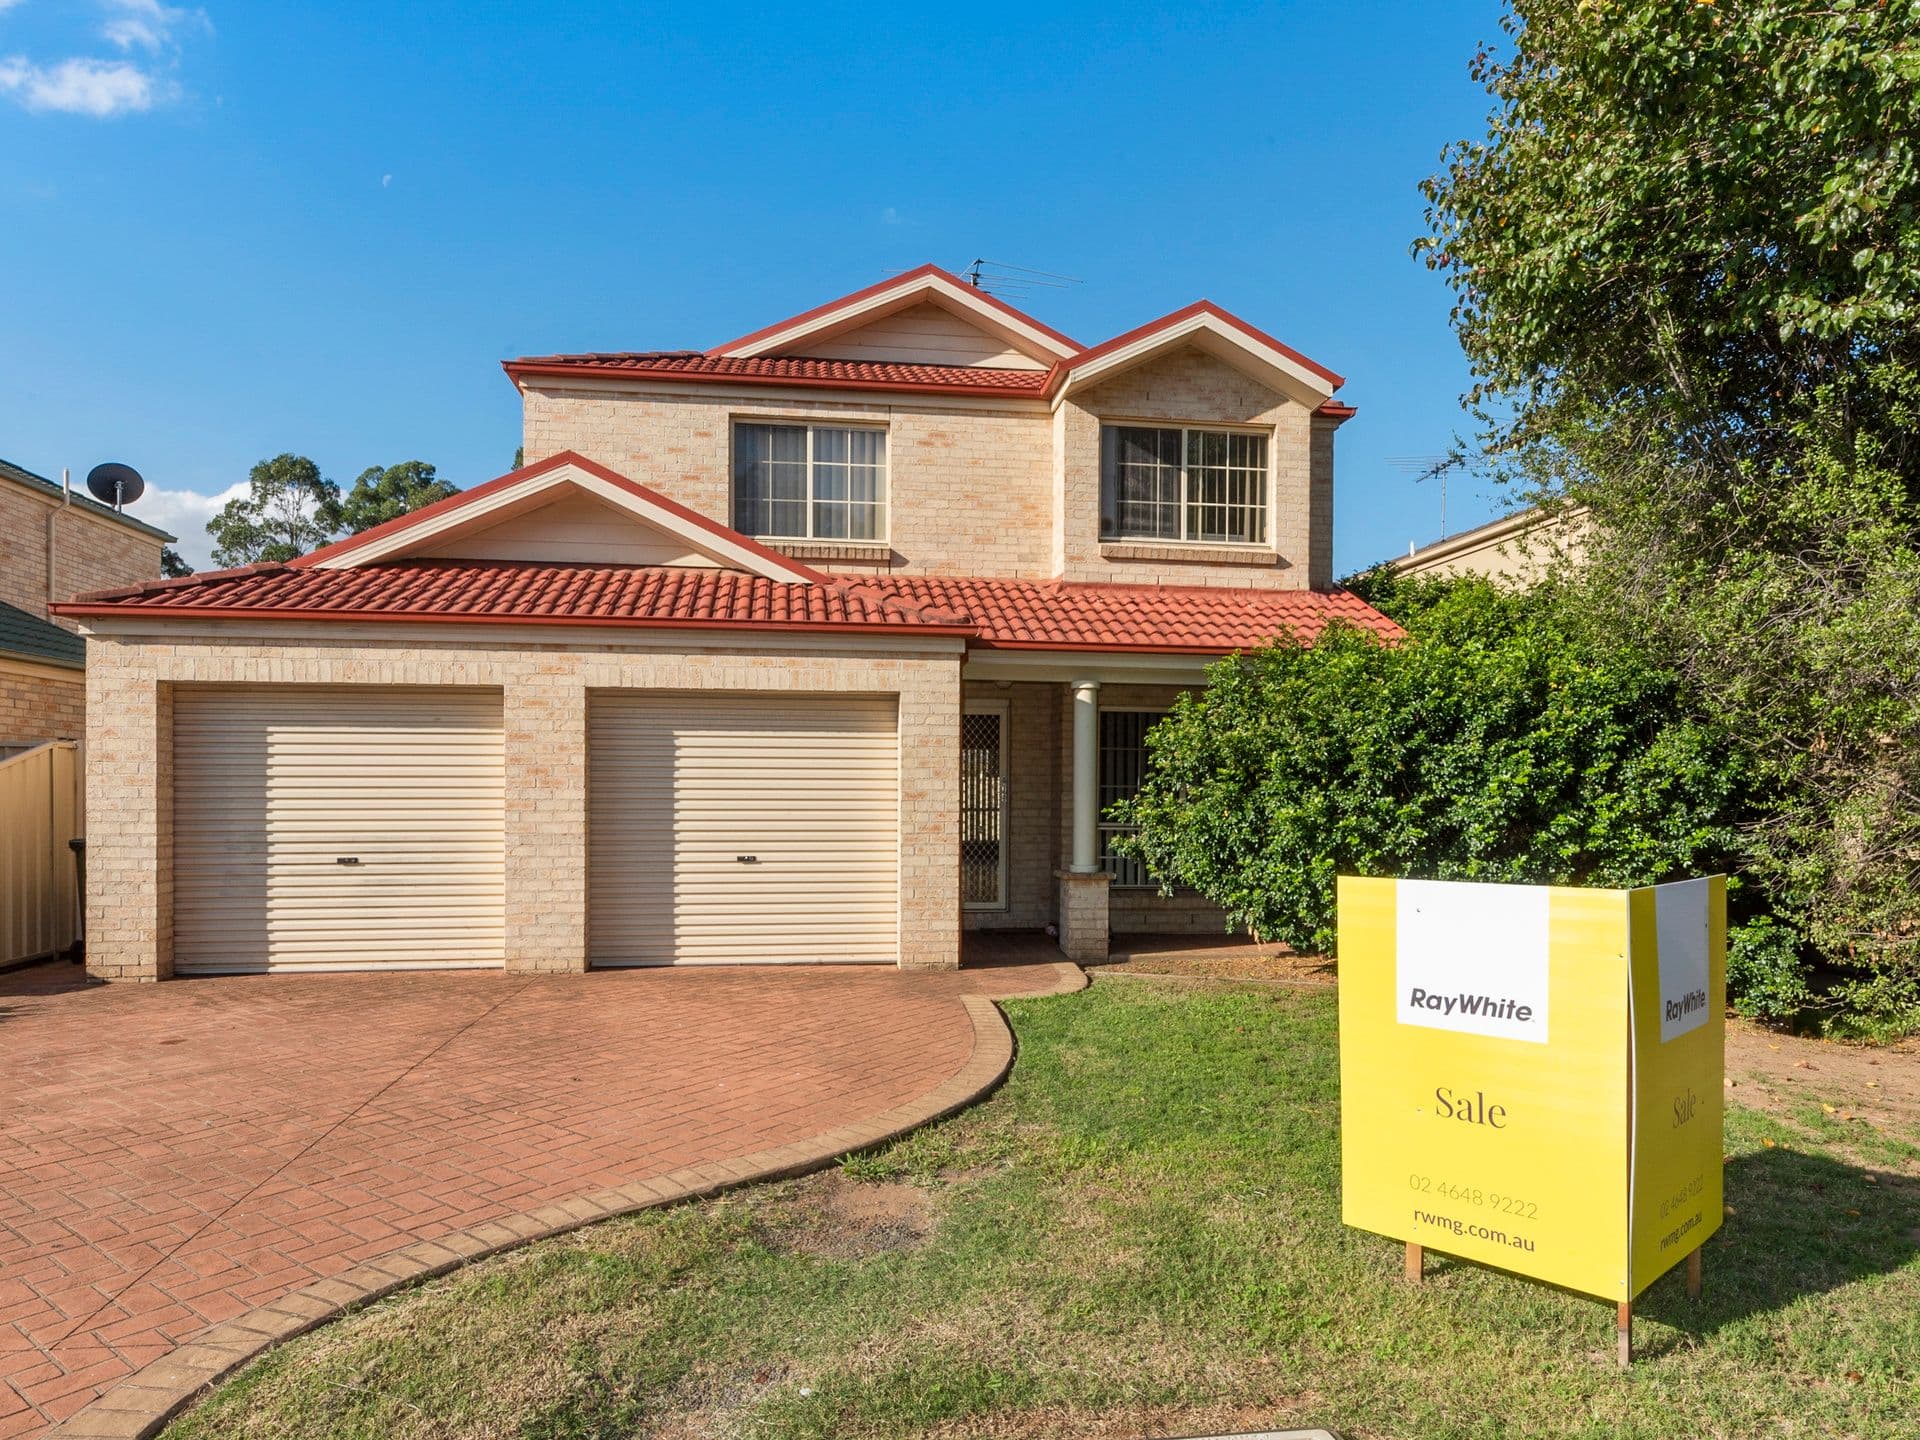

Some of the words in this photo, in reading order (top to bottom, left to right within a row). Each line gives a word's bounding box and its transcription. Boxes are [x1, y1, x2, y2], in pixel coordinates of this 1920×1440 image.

[1410, 987, 1533, 1022] RayWhite
[1665, 988, 1706, 1022] RayWhite
[1435, 1086, 1508, 1129] Sale
[1672, 1087, 1697, 1129] Sale
[1409, 1173, 1431, 1194] 02
[1437, 1181, 1483, 1207] 4648
[1489, 1193, 1539, 1220] 9222
[1413, 1209, 1536, 1253] rwmg.com.au
[1659, 1210, 1703, 1252] rwmg.com.au
